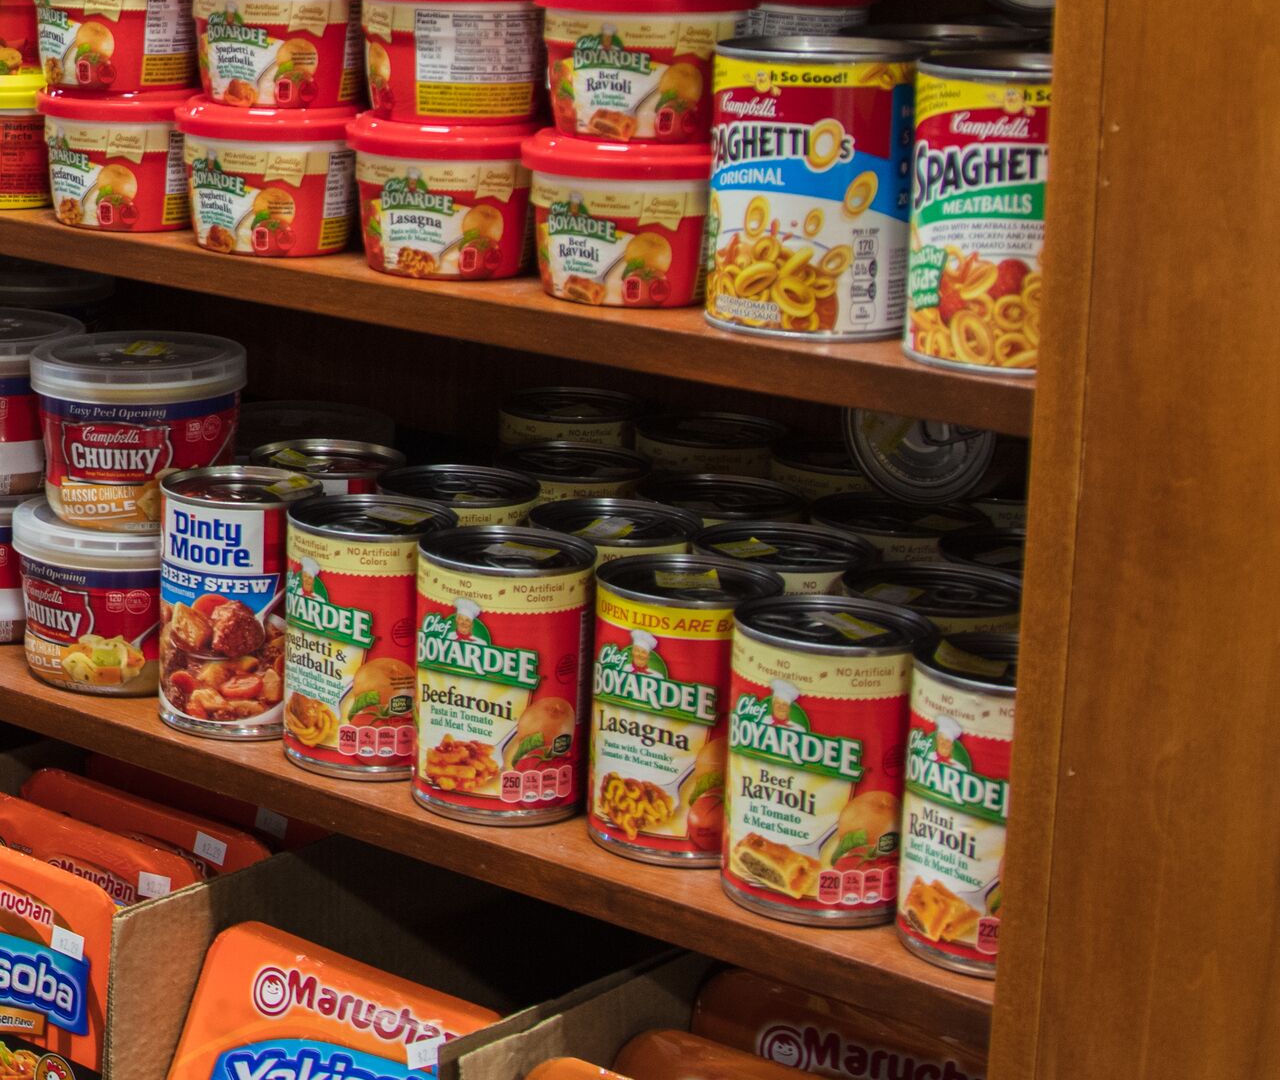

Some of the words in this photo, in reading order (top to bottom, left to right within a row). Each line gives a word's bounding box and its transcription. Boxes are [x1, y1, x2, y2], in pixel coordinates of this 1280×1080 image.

[573, 50, 653, 73] BOYARDEE
[598, 69, 620, 82] Beef
[781, 72, 798, 84] So
[801, 71, 848, 84] Good!
[586, 76, 633, 95] Ravioli
[951, 112, 1030, 140] Campbell's
[380, 191, 454, 215] BOYARDEE
[942, 194, 1033, 216] MEATBALLS
[389, 212, 443, 230] Lasagna
[857, 239, 874, 251] 170
[69, 404, 90, 418] Easy
[91, 405, 113, 418] Peel
[114, 406, 167, 420] Opening
[71, 443, 161, 474] CHUNKY
[62, 487, 98, 503] CLASSIC
[98, 485, 135, 500] CHICKEN
[64, 500, 137, 516] NOODLE
[172, 509, 242, 549] Dinty
[169, 535, 252, 568] Moore
[346, 547, 361, 557] NO
[362, 546, 401, 560] Artificial
[359, 555, 388, 567] Colors
[441, 585, 493, 602] Preservatives
[526, 592, 554, 603] Colors
[422, 614, 452, 640] Chef
[600, 602, 630, 623] OPEN
[631, 611, 671, 631] LIDS
[672, 616, 711, 634] ARE
[421, 683, 513, 722] Beefaroni
[340, 729, 357, 743] 260
[599, 709, 691, 752] Lasagna
[503, 776, 521, 790] 250
[741, 777, 817, 817] Ravioli
[921, 806, 954, 829] Mini
